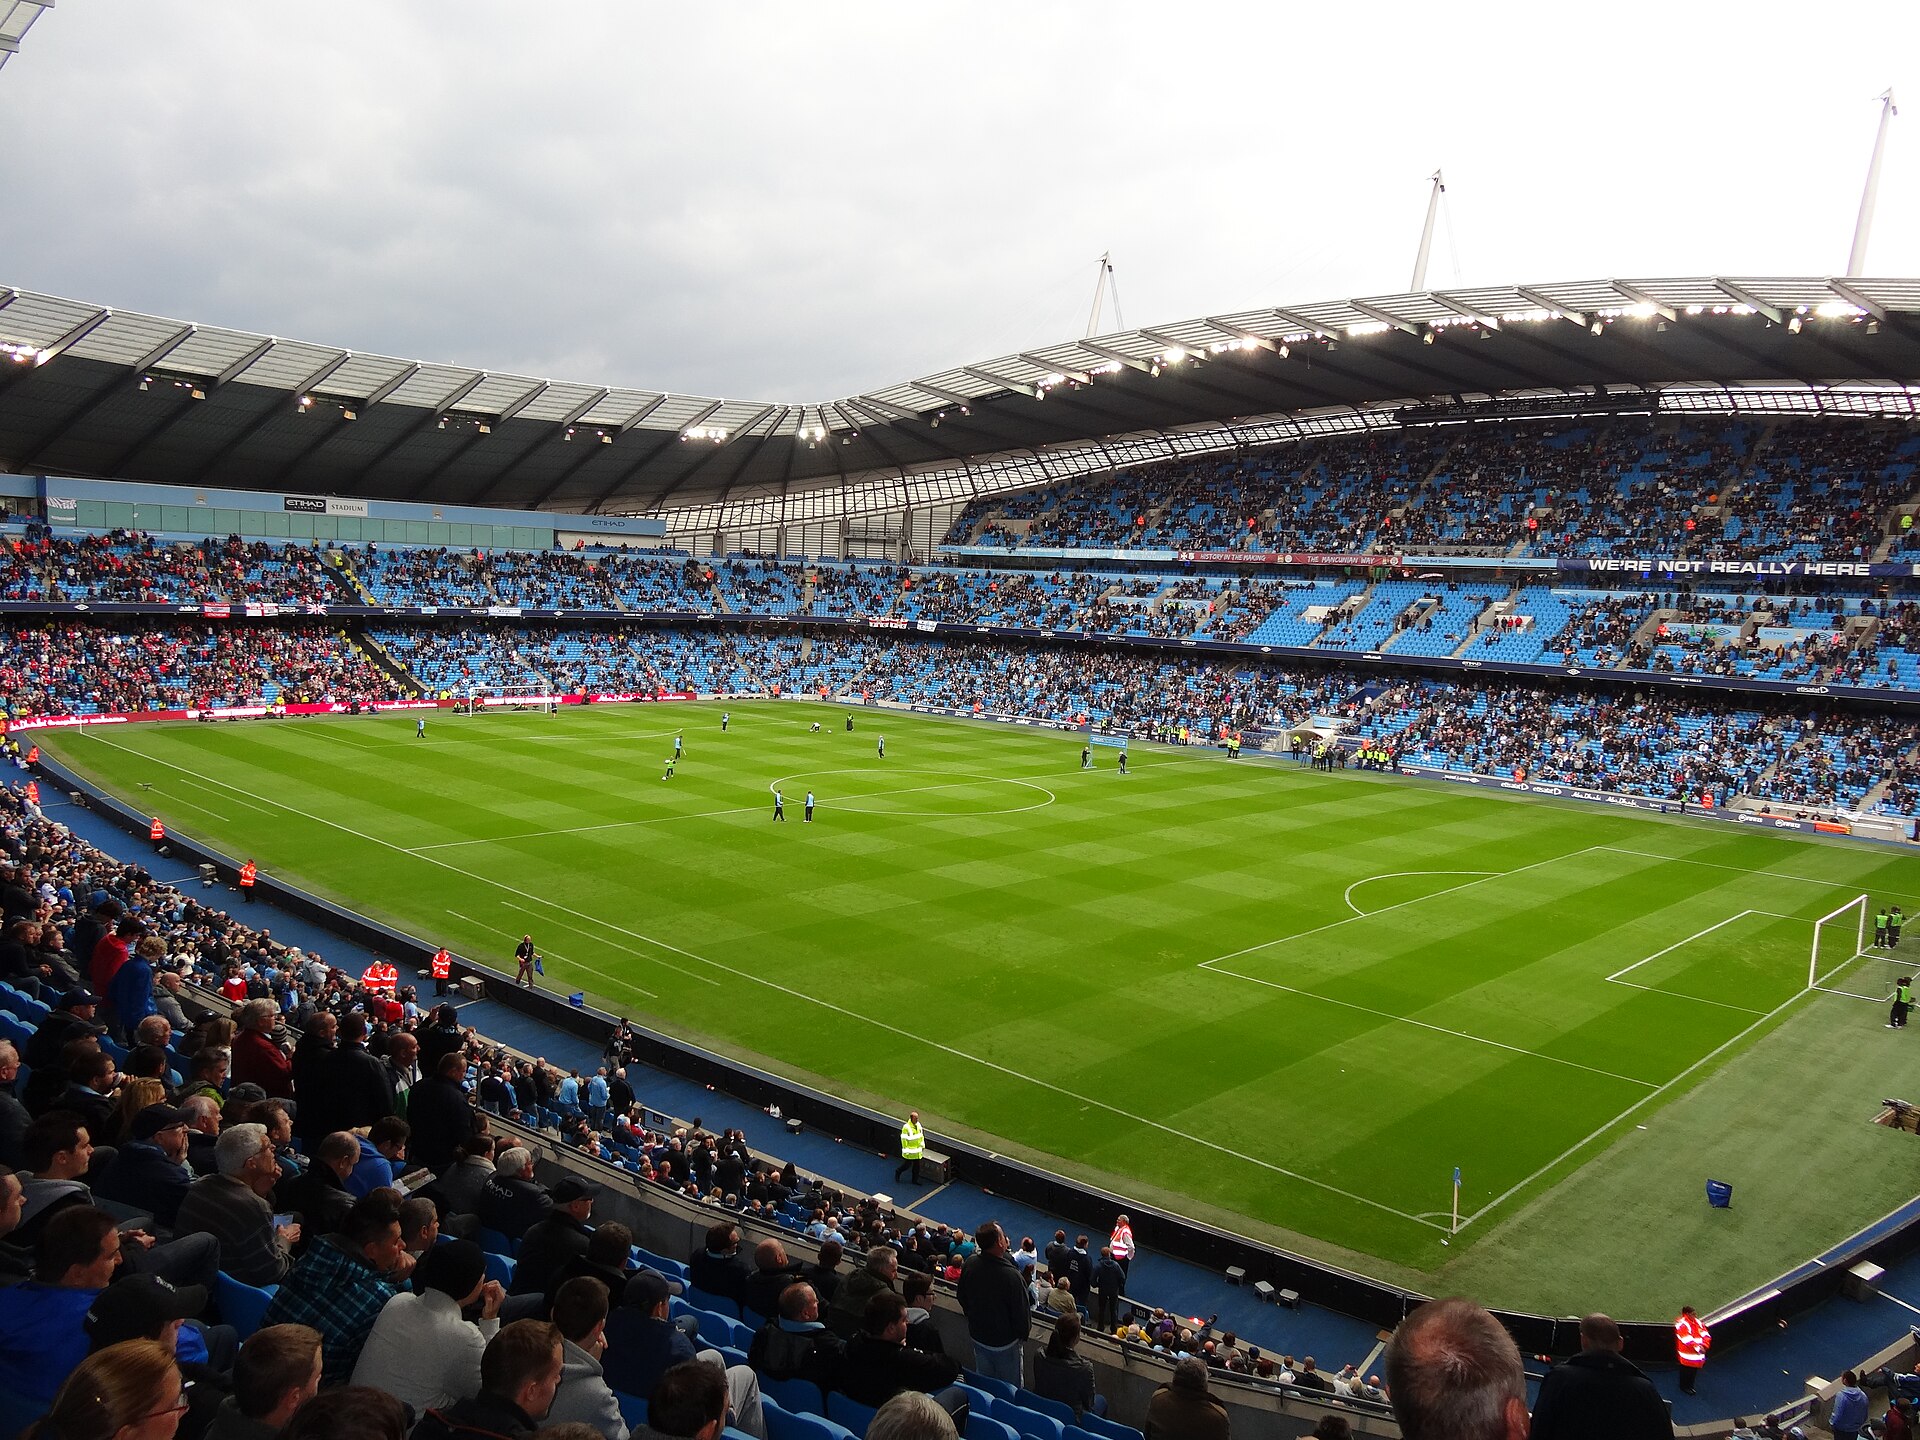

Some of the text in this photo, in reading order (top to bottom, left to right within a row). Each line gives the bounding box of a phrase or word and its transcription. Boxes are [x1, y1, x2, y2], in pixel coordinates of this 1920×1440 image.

[286, 499, 324, 508] ETIHAD
[331, 503, 364, 512] STADIUM
[591, 519, 626, 527] ETIHAD
[1307, 555, 1319, 563] THE
[1322, 556, 1358, 564] MANCUNIAN
[1589, 559, 1870, 576] WE'RE NOT REALLY HERE
[1135, 1308, 1146, 1318] 101
